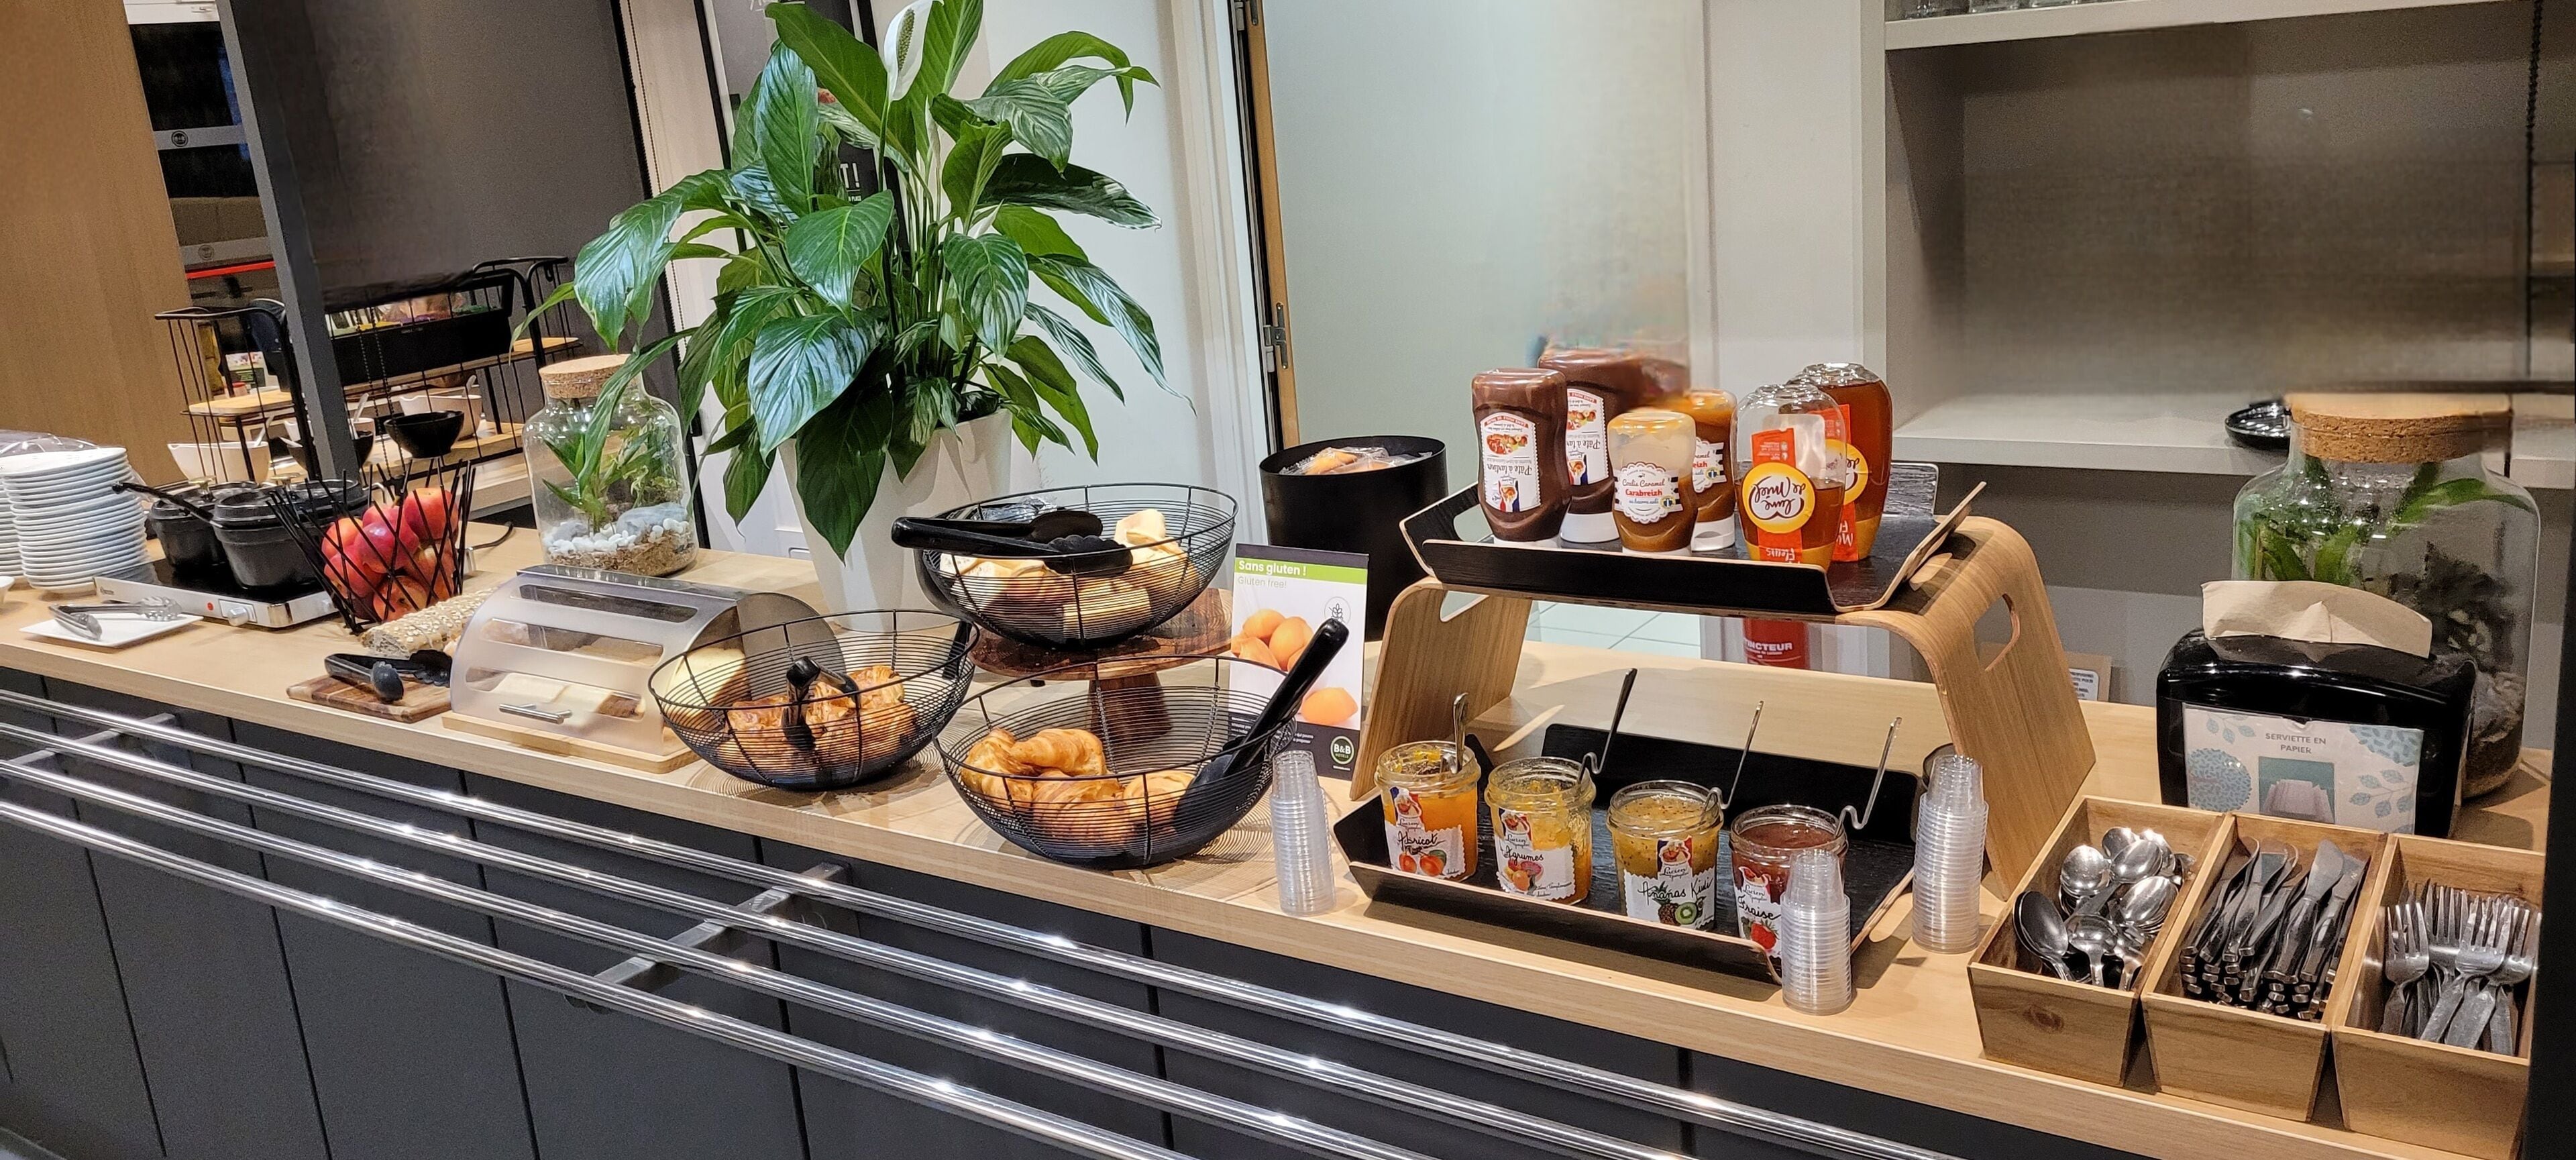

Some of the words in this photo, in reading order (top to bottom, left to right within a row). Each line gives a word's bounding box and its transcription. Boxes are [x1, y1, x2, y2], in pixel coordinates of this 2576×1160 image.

[1695, 451, 1710, 459] amel
[1514, 465, 1533, 476] Pâte
[1640, 478, 1666, 488] Caramel
[1625, 488, 1663, 497] Carabreizh
[1238, 560, 1265, 572] Sans
[1266, 563, 1301, 576] gluten
[1303, 565, 1307, 576] !
[1238, 576, 1265, 586] Gluten
[1267, 578, 1287, 588] free!
[2265, 733, 2311, 743] SERVIETTE
[2313, 737, 2326, 745] EN
[1333, 743, 1352, 755] B&B
[2280, 744, 2312, 754] PAPIER
[1398, 831, 1440, 850] Abricot
[1504, 845, 1544, 865] Agrumes
[1638, 881, 1686, 904] Ananas
[1691, 876, 1713, 898] Kiwi
[1737, 894, 1781, 920] Fraise
